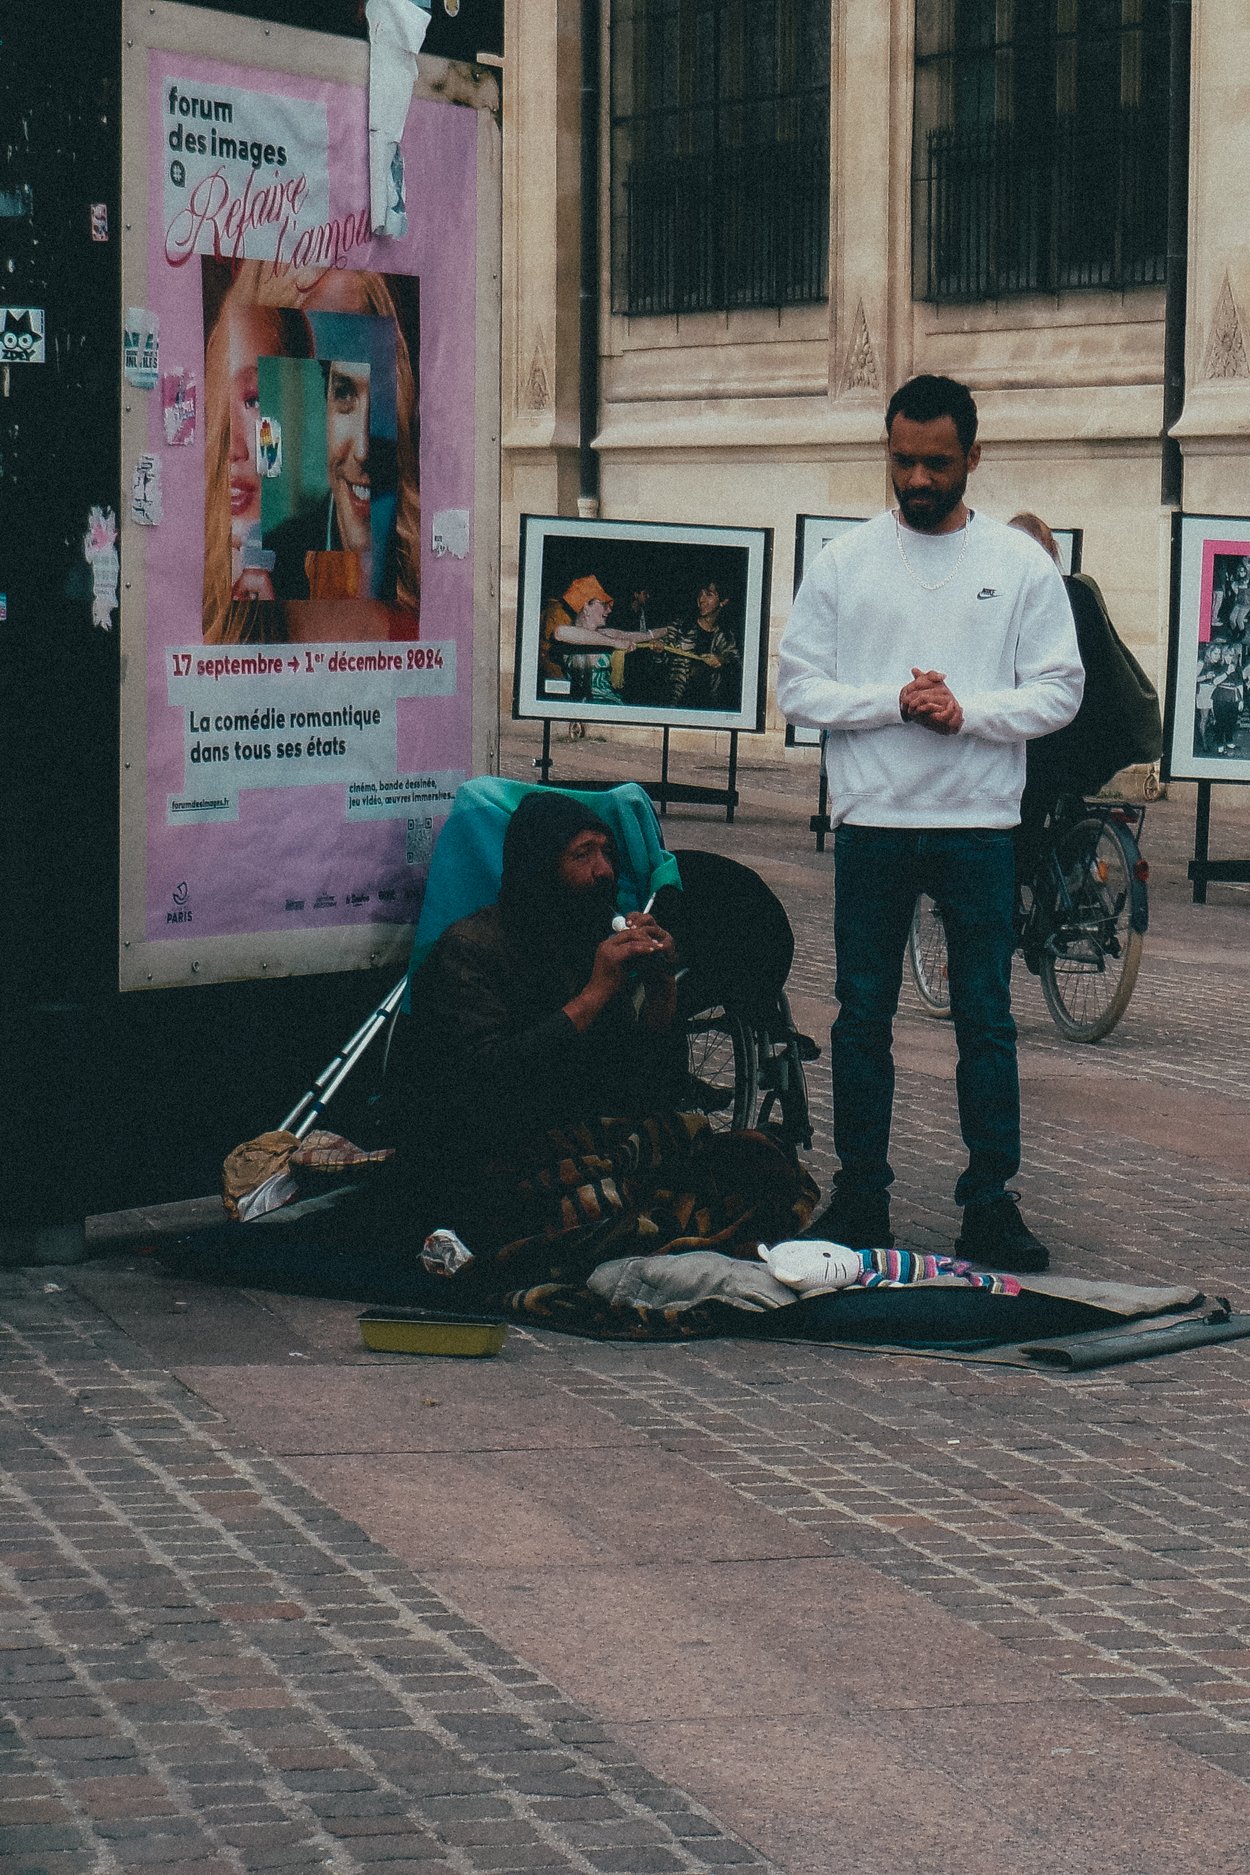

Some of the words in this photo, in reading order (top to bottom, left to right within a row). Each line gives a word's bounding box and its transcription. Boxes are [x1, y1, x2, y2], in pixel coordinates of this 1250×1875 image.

[168, 86, 233, 123] forum
[168, 123, 208, 154] des
[211, 128, 288, 169] images
[164, 165, 308, 282] Refaire
[172, 654, 192, 676] 17
[197, 652, 283, 681] septembre
[305, 651, 325, 673] 1er
[328, 649, 402, 672] décembre
[407, 648, 443, 670] 2024
[190, 711, 210, 733] La
[214, 707, 285, 731] comédie
[290, 704, 381, 731] romantique
[190, 741, 230, 763] dans
[235, 741, 272, 761] tous
[276, 741, 302, 758] ses
[306, 735, 346, 757] états
[349, 782, 378, 794] cinéma,
[379, 780, 403, 791] bande
[405, 777, 437, 790] dessinée,
[171, 797, 229, 810] forumdesimages.fr
[348, 796, 361, 810] jeu
[362, 794, 383, 807] vidéo,
[166, 911, 193, 924] PARIS
